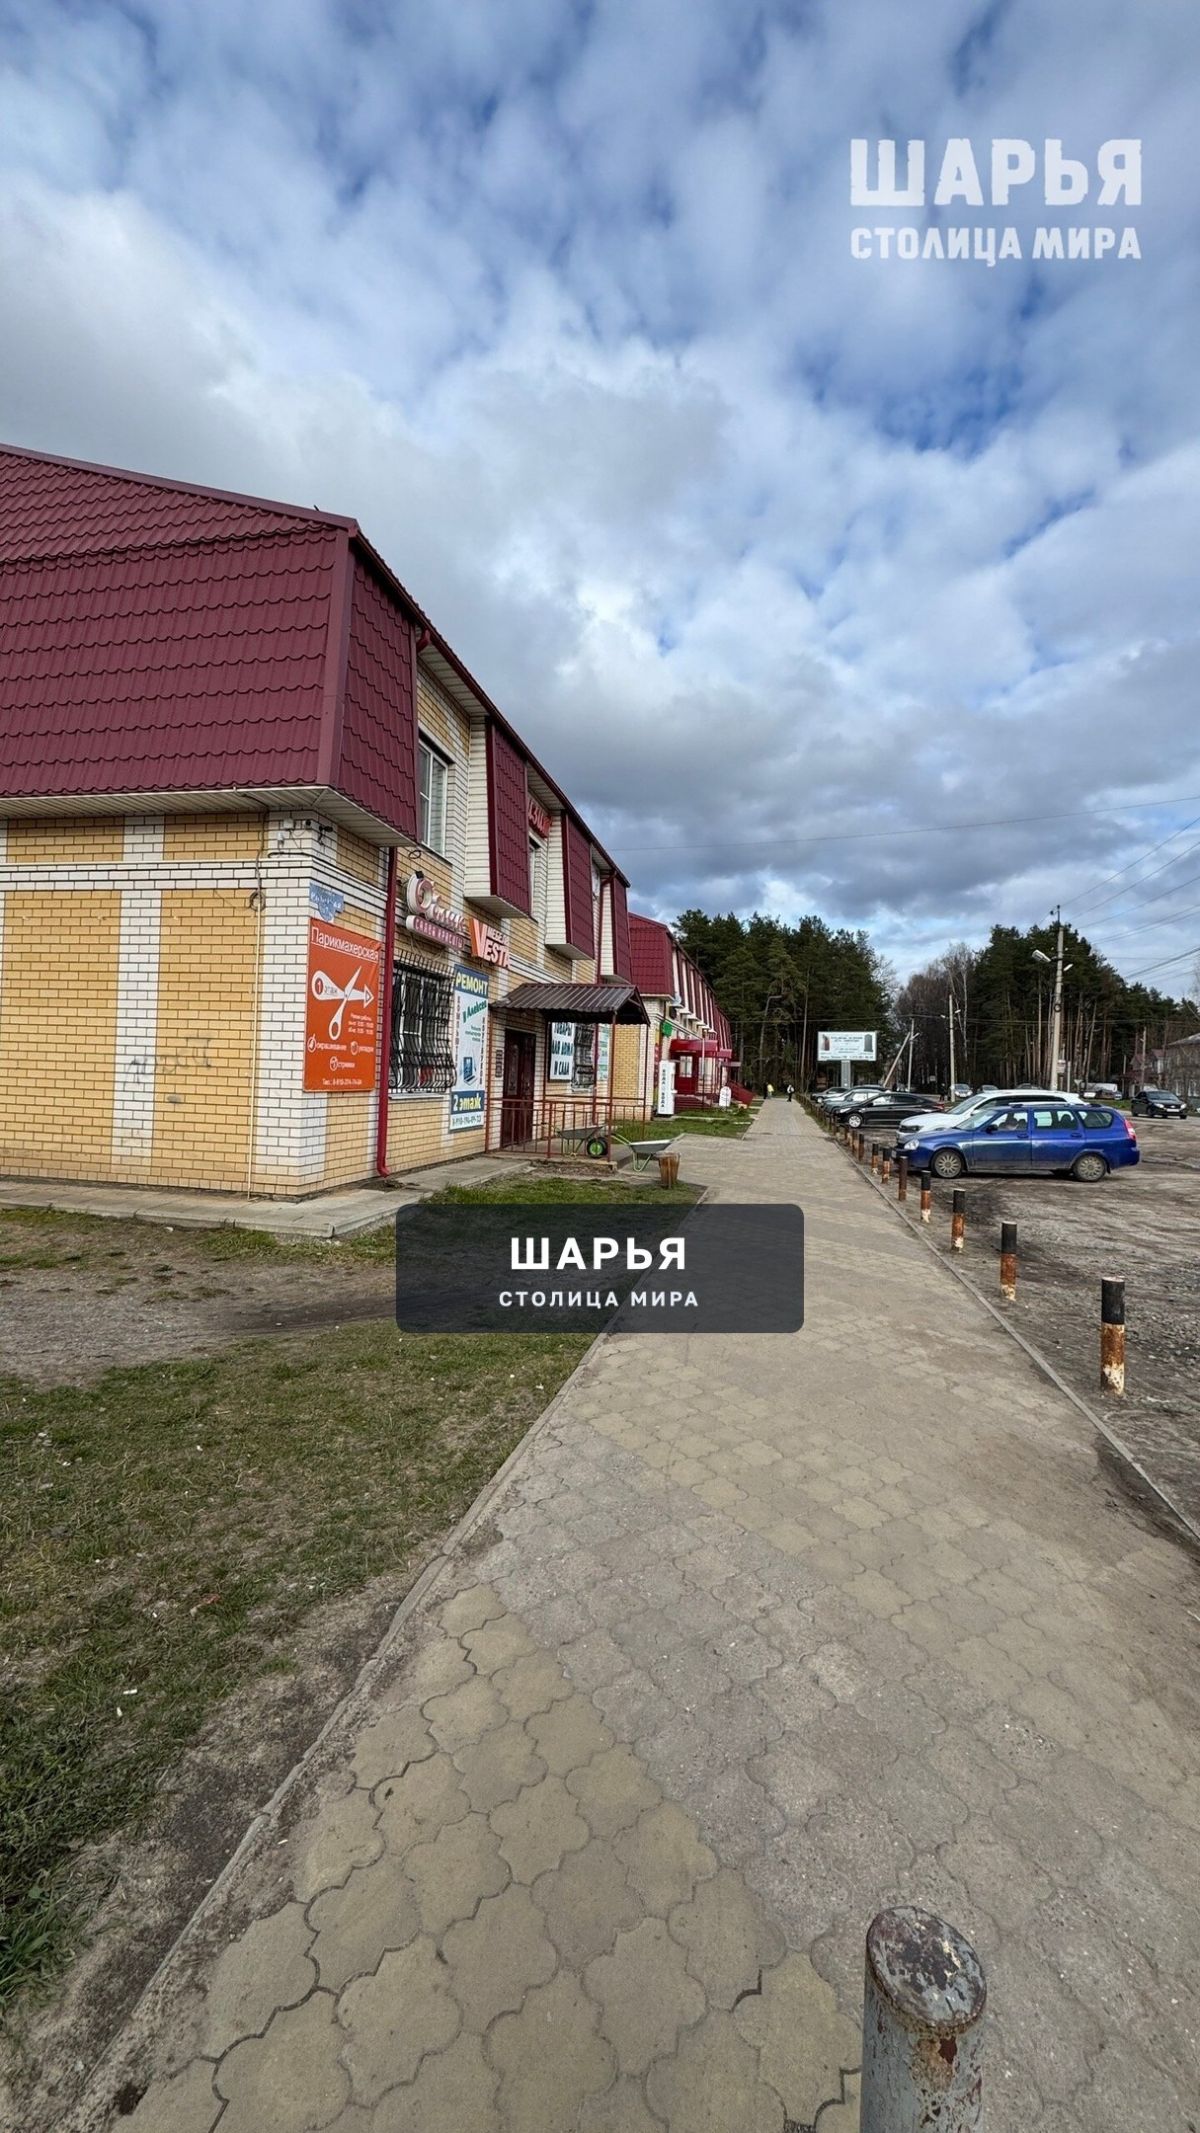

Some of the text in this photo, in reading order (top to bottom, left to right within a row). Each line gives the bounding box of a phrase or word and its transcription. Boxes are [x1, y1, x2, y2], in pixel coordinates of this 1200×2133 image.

[311, 926, 379, 961] Парикмахерская
[455, 973, 488, 995] РЕМОНТ
[453, 1094, 459, 1112] 2
